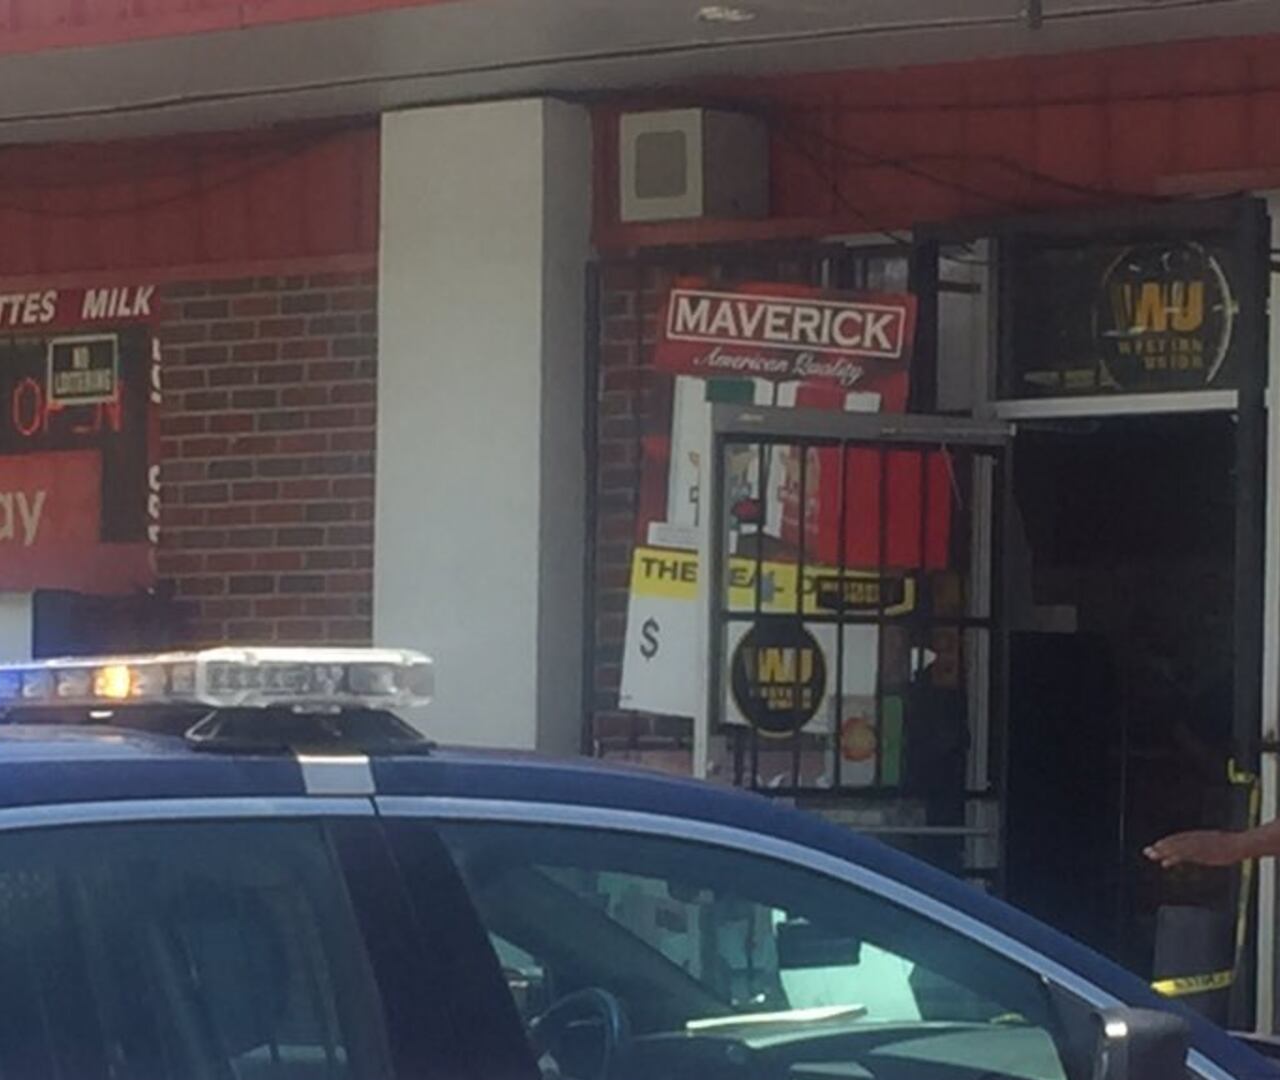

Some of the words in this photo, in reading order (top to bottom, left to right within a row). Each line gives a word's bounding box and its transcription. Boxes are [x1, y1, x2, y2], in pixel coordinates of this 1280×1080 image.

[81, 286, 154, 320] MILK
[675, 297, 895, 350] MAVERICK
[72, 346, 89, 369] NO
[693, 347, 789, 373] American
[792, 353, 864, 385] Quality
[640, 556, 699, 583] THE
[639, 616, 660, 662] $
